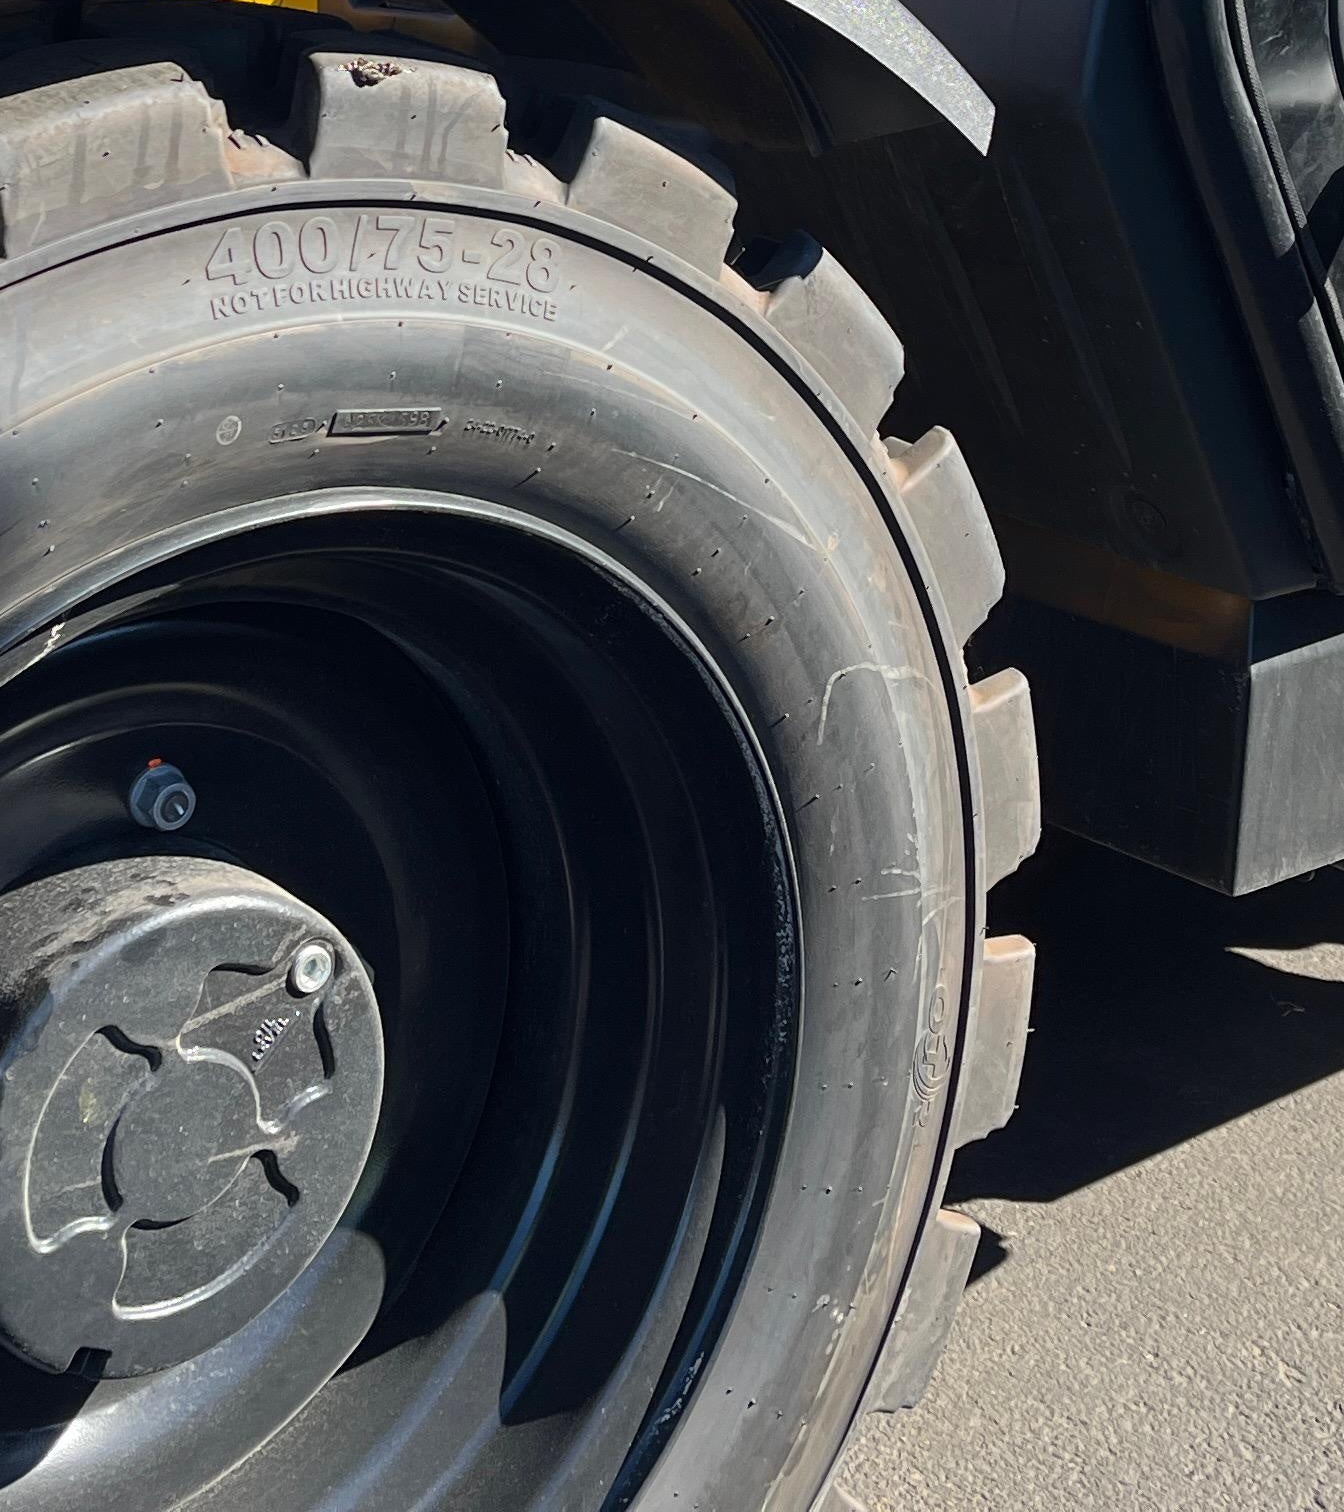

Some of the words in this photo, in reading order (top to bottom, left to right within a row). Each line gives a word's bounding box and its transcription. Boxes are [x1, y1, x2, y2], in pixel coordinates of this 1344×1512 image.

[205, 214, 561, 294] 400/75-28
[210, 289, 269, 320] NOT
[272, 277, 325, 307] FOR
[330, 277, 451, 302] HIGHWAY
[457, 283, 558, 322] SERVICE
